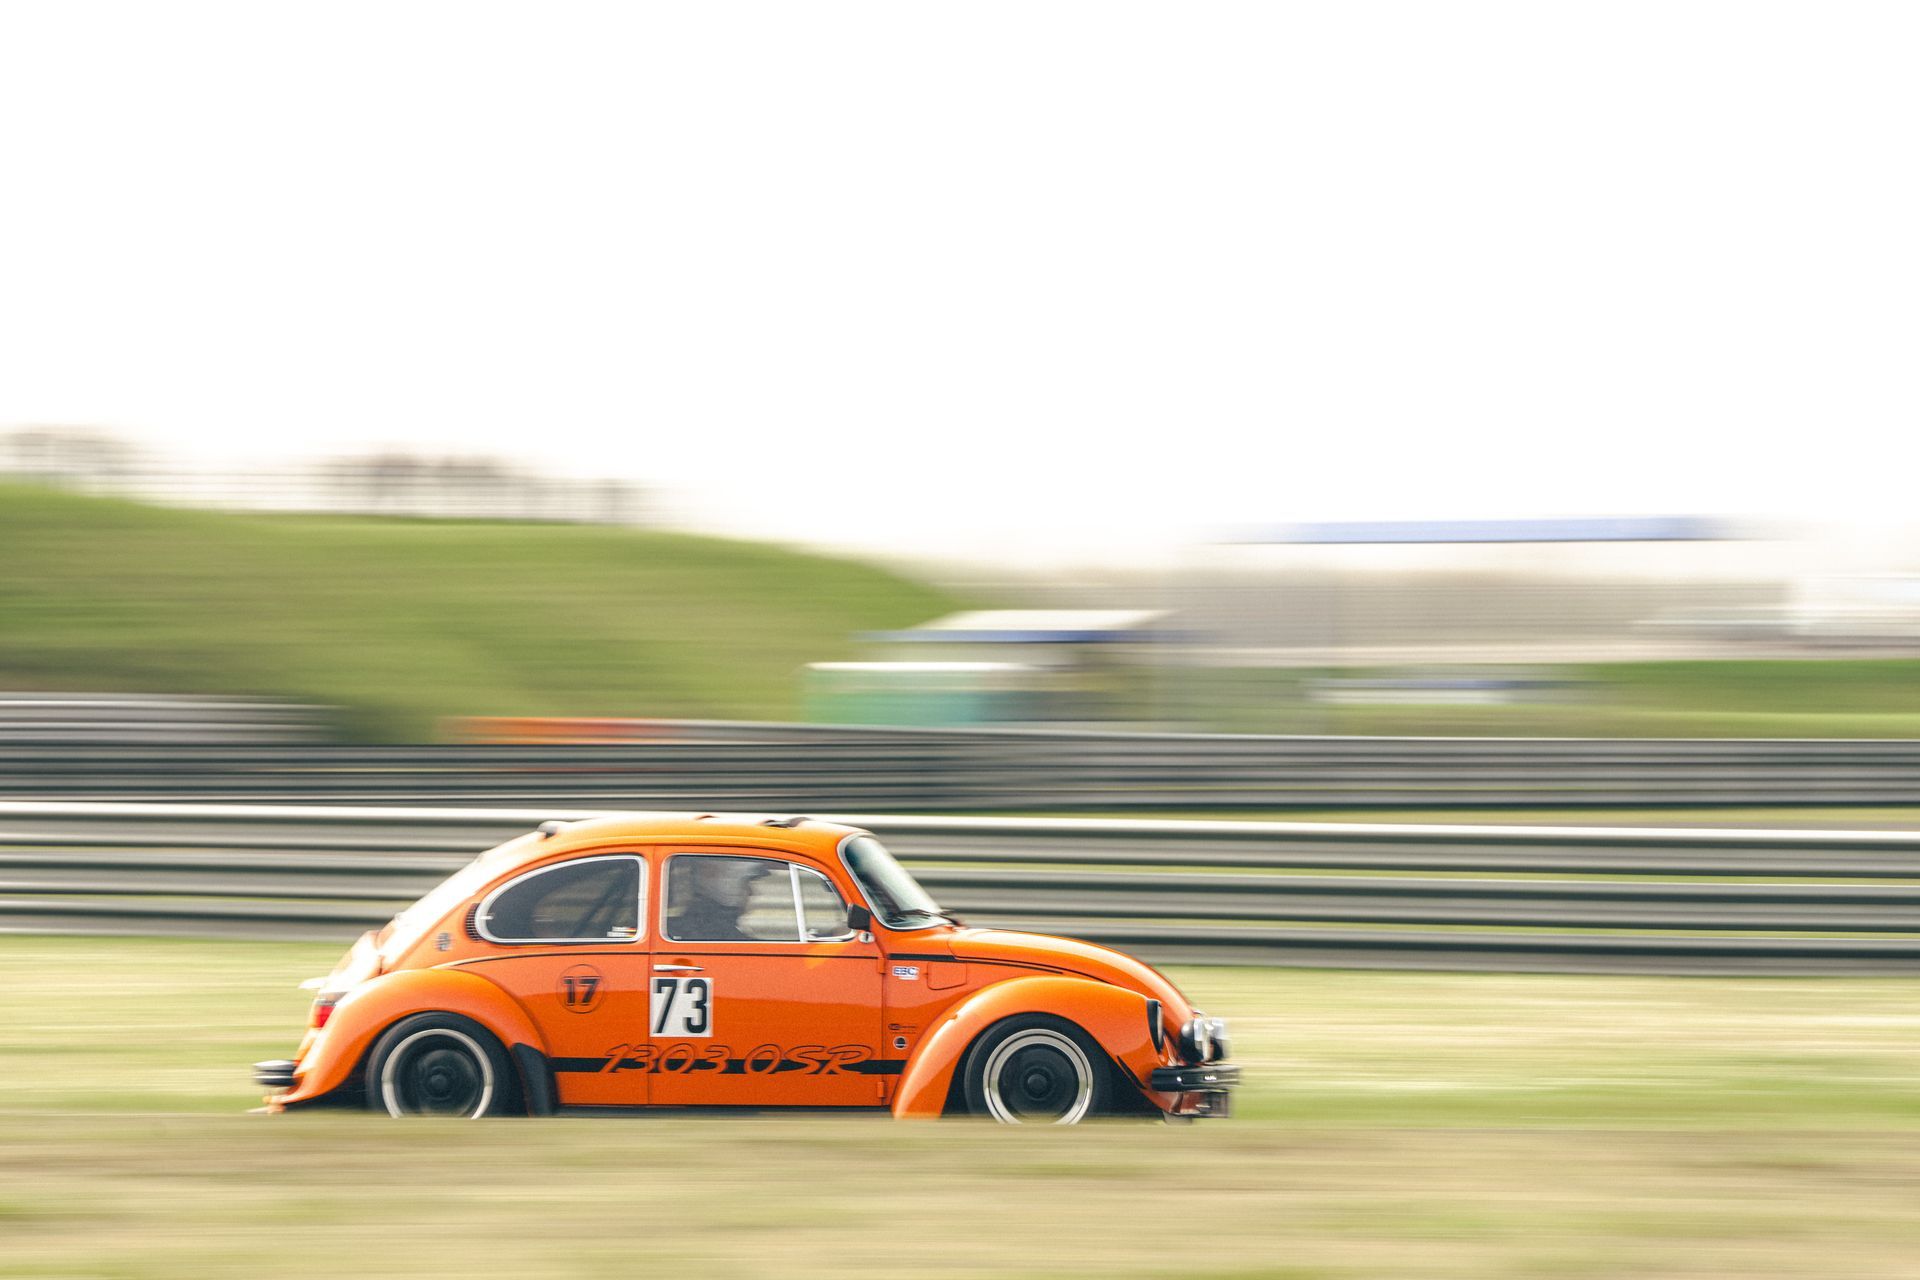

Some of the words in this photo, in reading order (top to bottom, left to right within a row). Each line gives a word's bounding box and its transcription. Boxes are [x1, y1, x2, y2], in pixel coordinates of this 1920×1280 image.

[562, 976, 602, 1006] 17
[653, 978, 708, 1034] 73
[600, 1043, 732, 1074] 1303
